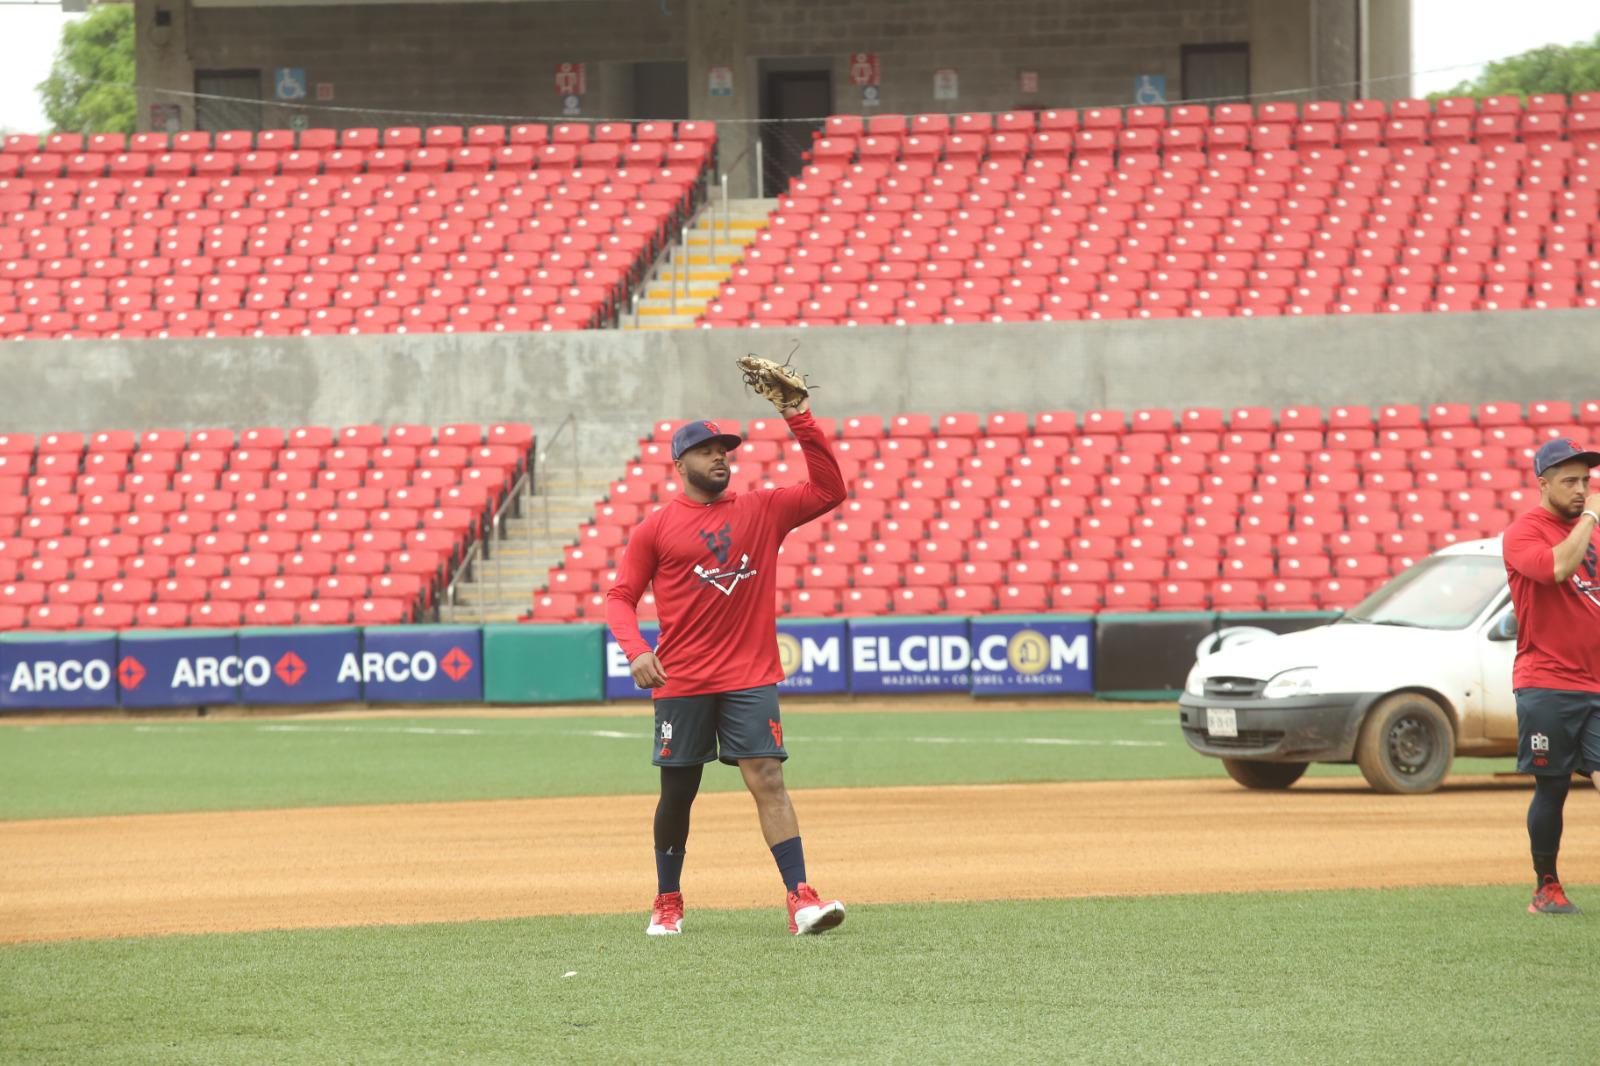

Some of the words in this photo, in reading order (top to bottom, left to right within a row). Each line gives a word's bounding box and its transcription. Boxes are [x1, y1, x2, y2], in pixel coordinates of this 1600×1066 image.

[337, 650, 437, 683] ARCO
[852, 630, 1089, 674] ELCID.COM
[9, 659, 111, 692] ARCO
[171, 656, 271, 688] ARCO
